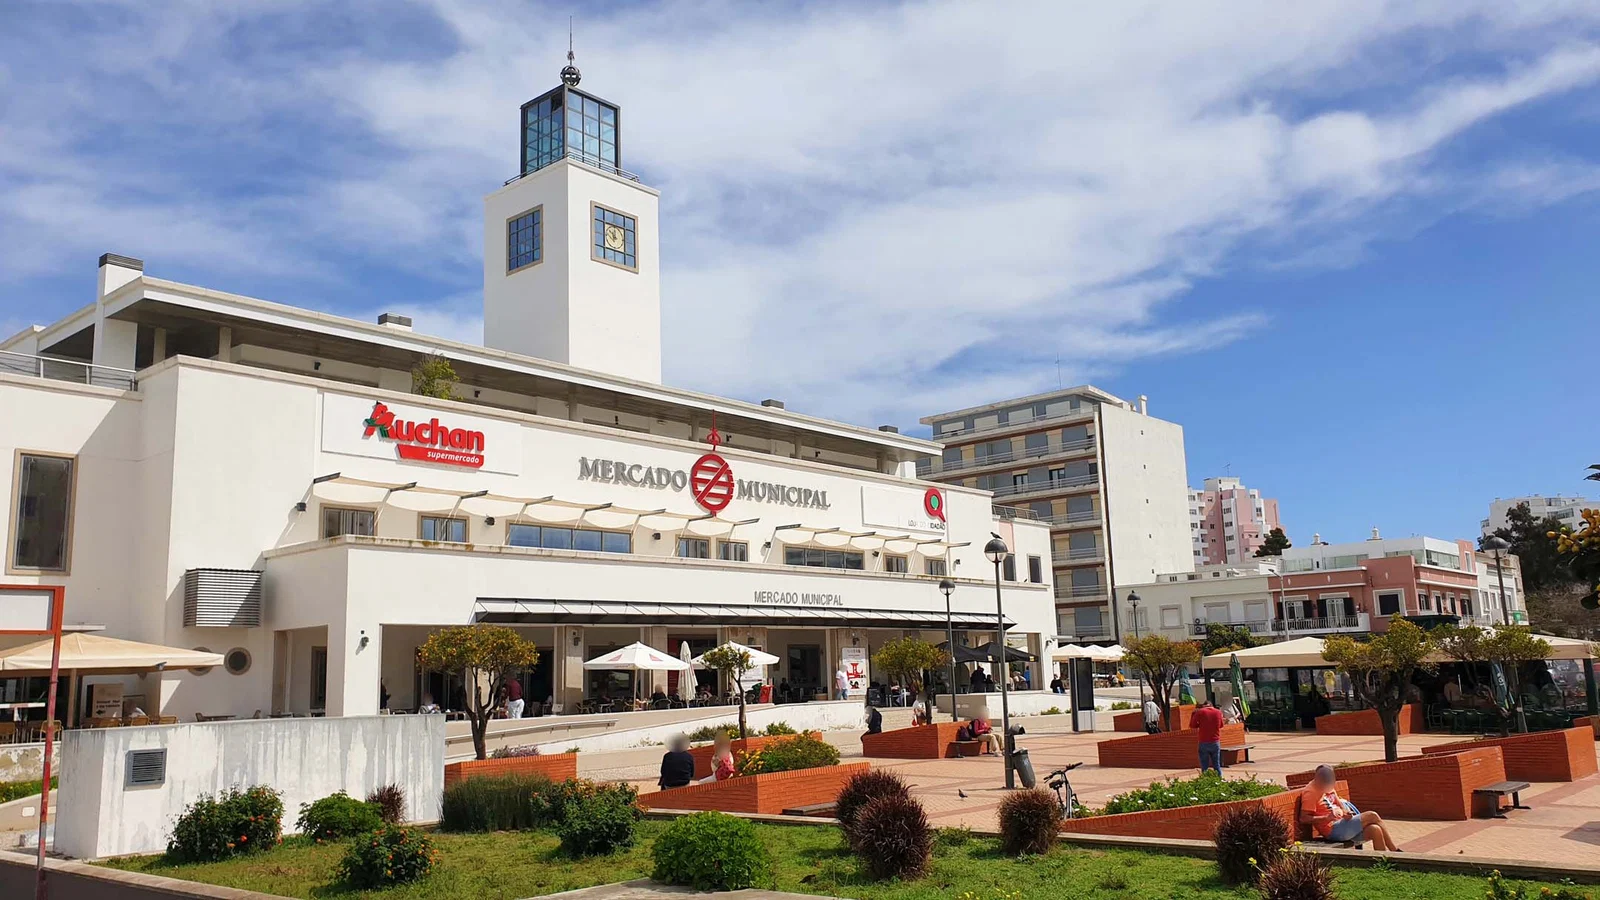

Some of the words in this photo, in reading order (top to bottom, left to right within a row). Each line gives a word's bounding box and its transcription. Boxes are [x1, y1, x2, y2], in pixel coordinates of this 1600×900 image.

[362, 400, 485, 451] Auchan
[427, 450, 480, 464] supermercado
[578, 457, 687, 491] MERCADO
[736, 479, 831, 509] MUNICIPAL
[754, 591, 798, 604] MERCADO
[801, 593, 843, 606] MUNICIPAL
